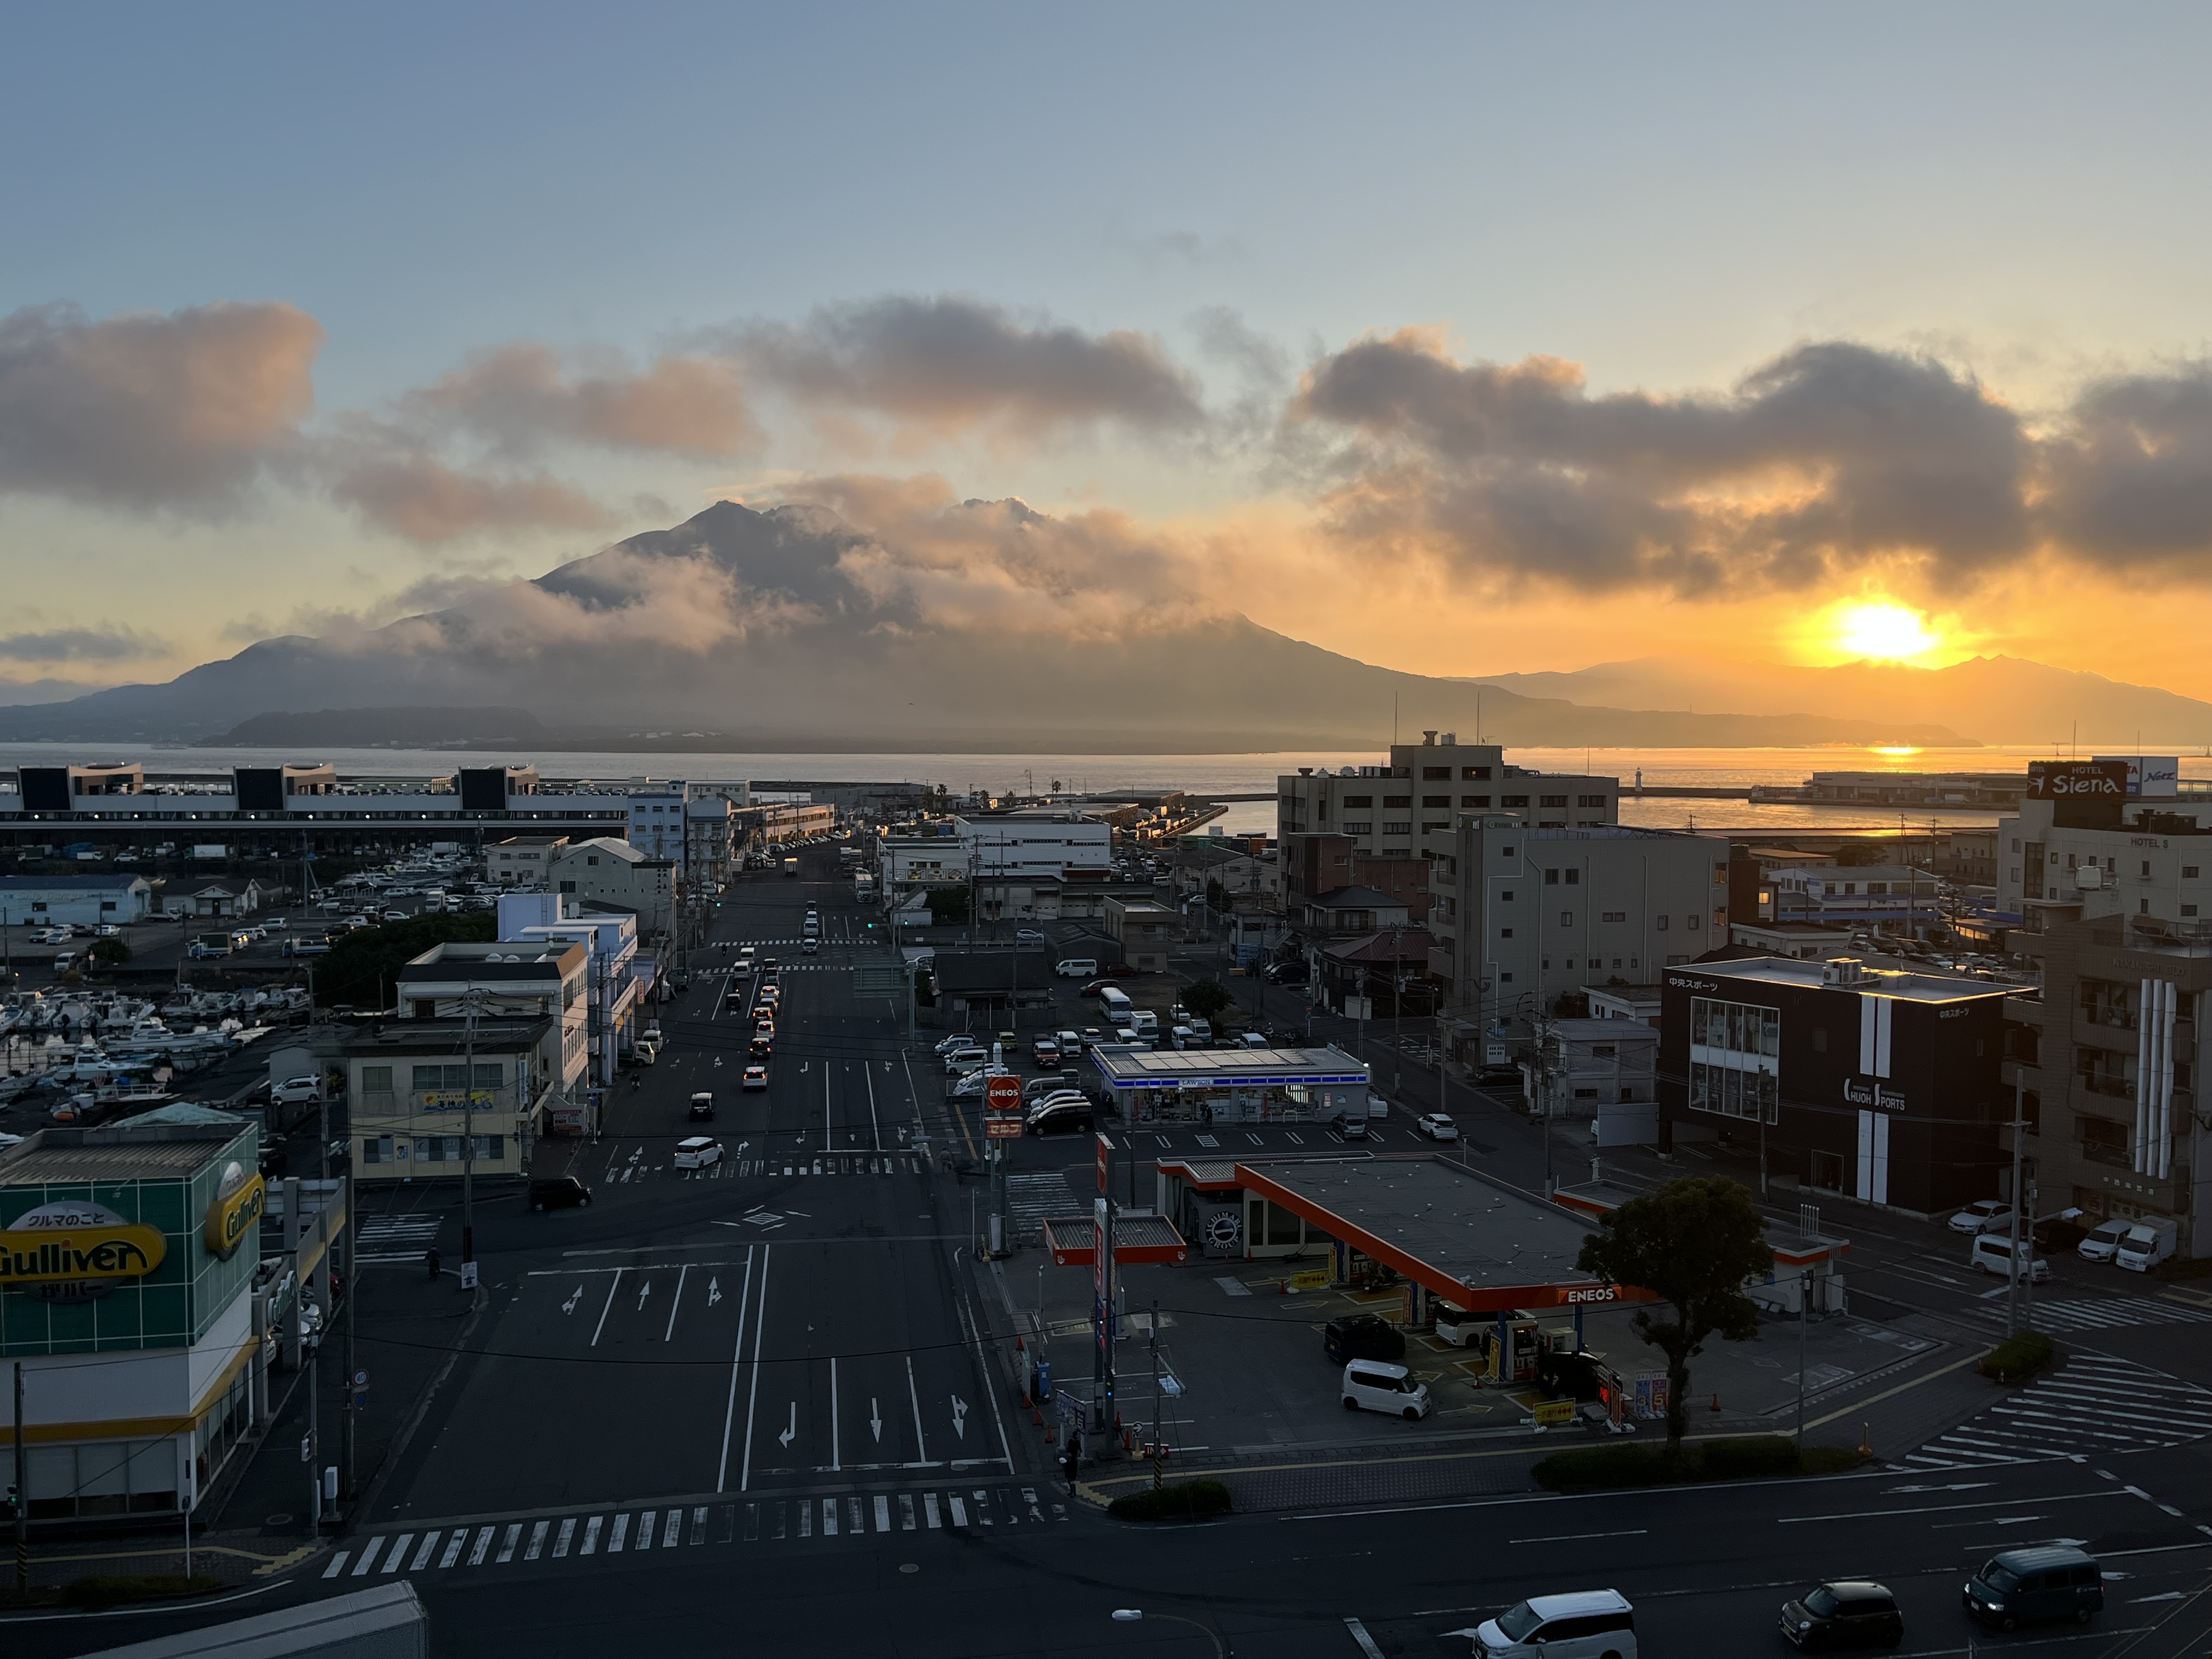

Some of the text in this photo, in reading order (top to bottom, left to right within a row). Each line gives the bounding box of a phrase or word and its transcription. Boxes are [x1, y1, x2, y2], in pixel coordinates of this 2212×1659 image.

[2072, 766, 2103, 775] HOTEL
[2052, 775, 2122, 794] Siena
[2131, 837, 2169, 849] HOTEL S
[1669, 977, 1718, 991] 中央スポーツ
[1939, 1007, 1970, 1019] 中央スポーツ
[990, 1089, 1019, 1097] ENEOS
[1843, 1078, 1905, 1111] CHUOH SPORTS
[990, 1124, 1019, 1135] セルフ
[29, 1213, 104, 1227] クルマのこと
[226, 1187, 263, 1242] Gulliver
[1206, 1211, 1243, 1232] ICHIMARU
[1208, 1236, 1239, 1249] GROUP
[41, 1282, 103, 1298] ガリバー
[1568, 1288, 1614, 1302] ENEOS
[357, 1373, 365, 1382] 40
